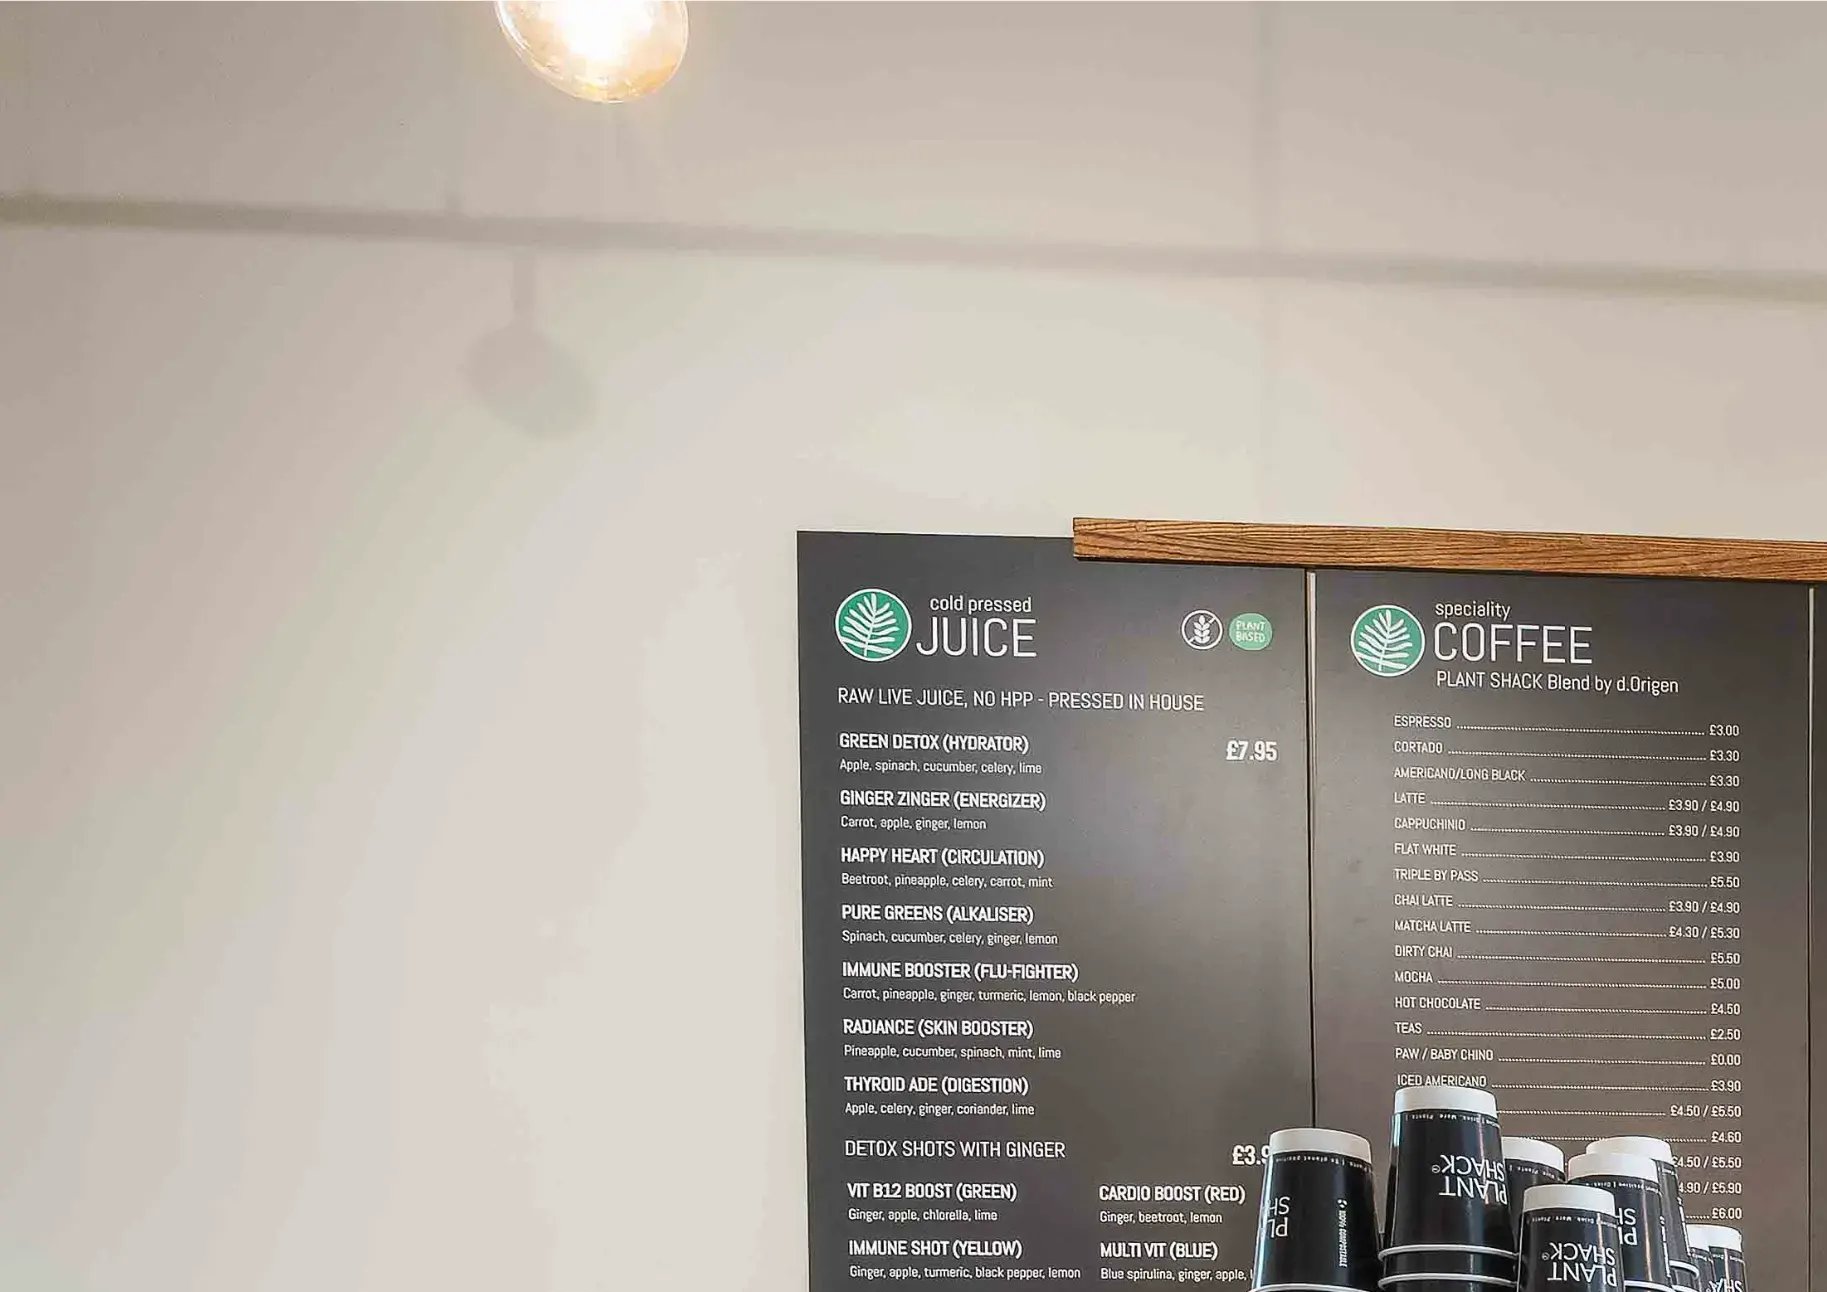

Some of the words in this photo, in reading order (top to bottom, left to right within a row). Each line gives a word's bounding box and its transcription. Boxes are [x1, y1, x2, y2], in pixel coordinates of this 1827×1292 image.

[931, 595, 963, 610] cold
[969, 597, 1031, 614] pressed
[1436, 601, 1510, 621] speciality
[1236, 620, 1265, 630] PLANT
[917, 617, 1036, 657] JUICE
[1236, 631, 1265, 642] BASED
[1435, 622, 1592, 663] COFFEE
[1437, 671, 1485, 687] PLANT
[1491, 672, 1542, 689] SHACK
[1548, 674, 1589, 690] Blend
[1595, 676, 1612, 694] by
[1617, 676, 1678, 696] d.Origen
[1395, 716, 1451, 728] ESPRESSO
[1710, 725, 1739, 736] £3.00
[840, 733, 888, 748] GREEN
[893, 734, 939, 749] DETOX
[943, 734, 1028, 754] (HYDRATOR)
[1226, 741, 1276, 760] £7.95
[841, 816, 877, 828] Carrot,
[881, 817, 912, 830] apple,
[916, 820, 950, 831] ginger,
[954, 818, 986, 829] lemon
[842, 848, 888, 862] HAPPY
[892, 848, 938, 863] HEART
[942, 848, 1044, 868] (CIRCULATION)
[1395, 843, 1419, 854] FLAT
[1422, 844, 1456, 855] WHITE
[1710, 851, 1739, 862] £3.90
[1396, 997, 1416, 1008] HOT
[1420, 997, 1480, 1009] CHOCOLATE
[1711, 1003, 1740, 1014] £4.50
[846, 1141, 897, 1156] DETOX
[903, 1141, 955, 1157] SHOTS
[960, 1141, 1000, 1157] WITH
[1007, 1142, 1065, 1157] GINGER
[1439, 1184, 1507, 1205] PLANT
[1550, 1243, 1616, 1268] SHACK
[1548, 1263, 1617, 1287] PLANT
